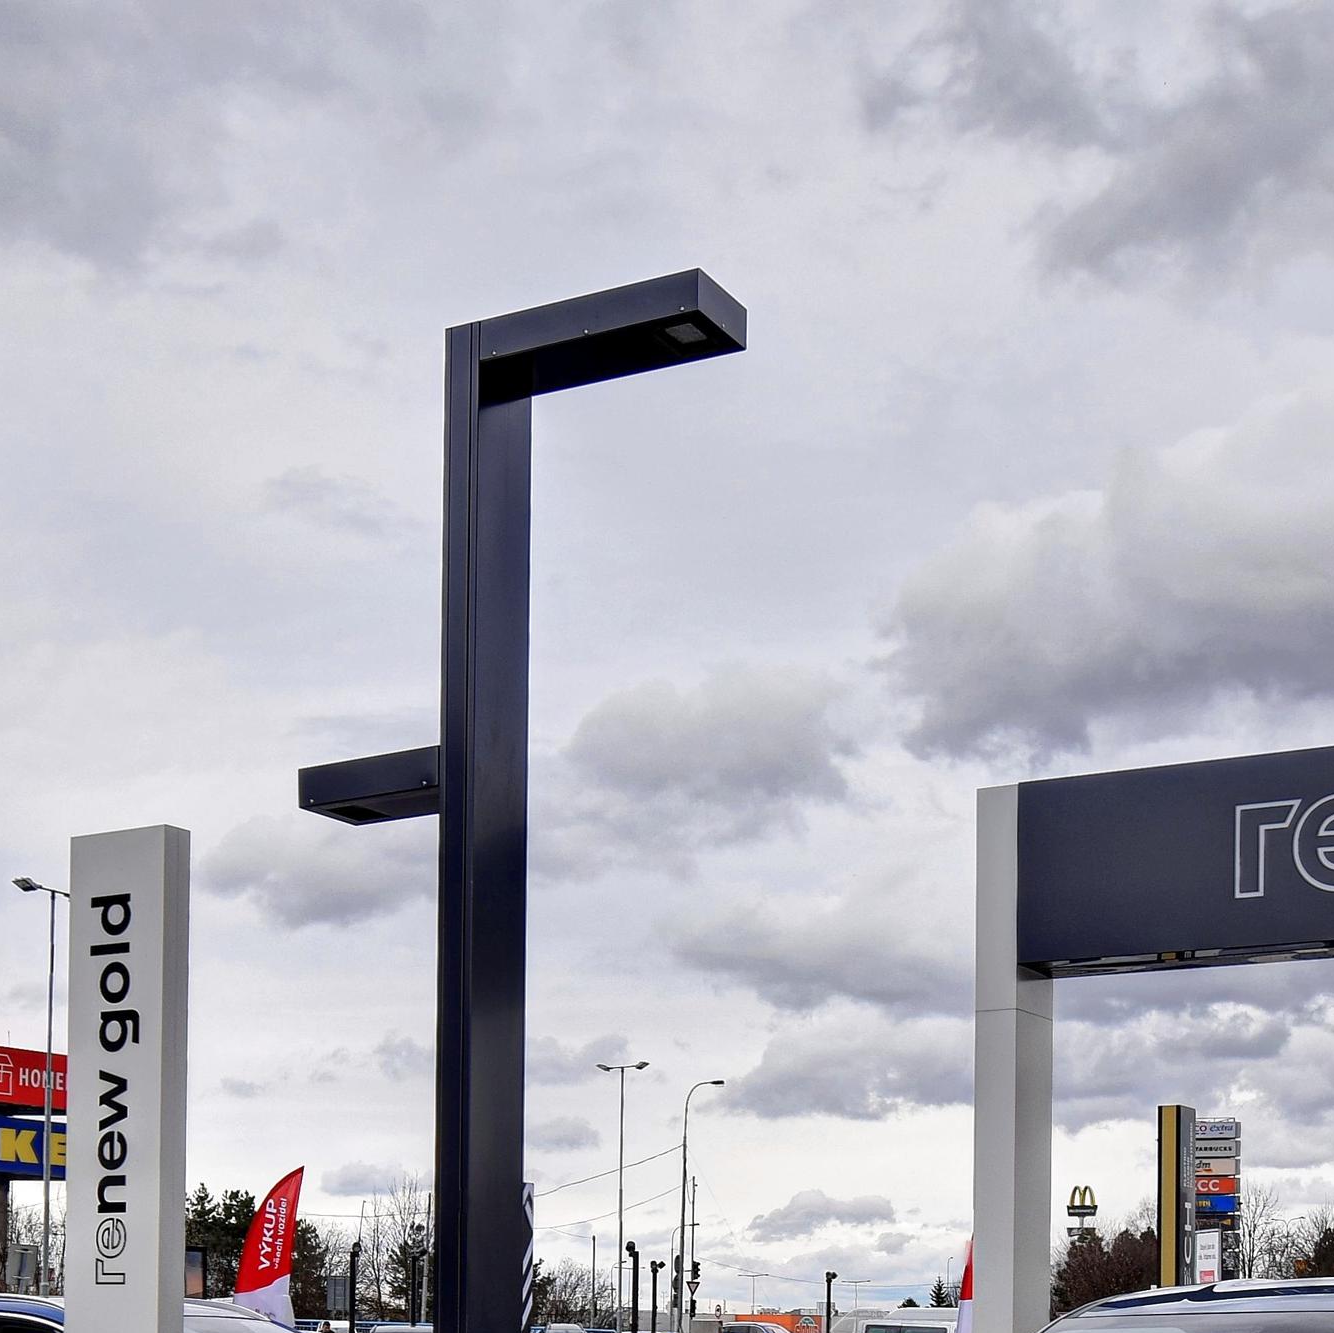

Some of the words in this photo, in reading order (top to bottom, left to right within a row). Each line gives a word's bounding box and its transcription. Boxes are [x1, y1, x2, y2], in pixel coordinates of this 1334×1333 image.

[89, 892, 140, 1053] gold
[94, 1070, 129, 1286] renew
[258, 1198, 278, 1271] VÝKUP
[277, 1197, 288, 1236] vozidel
